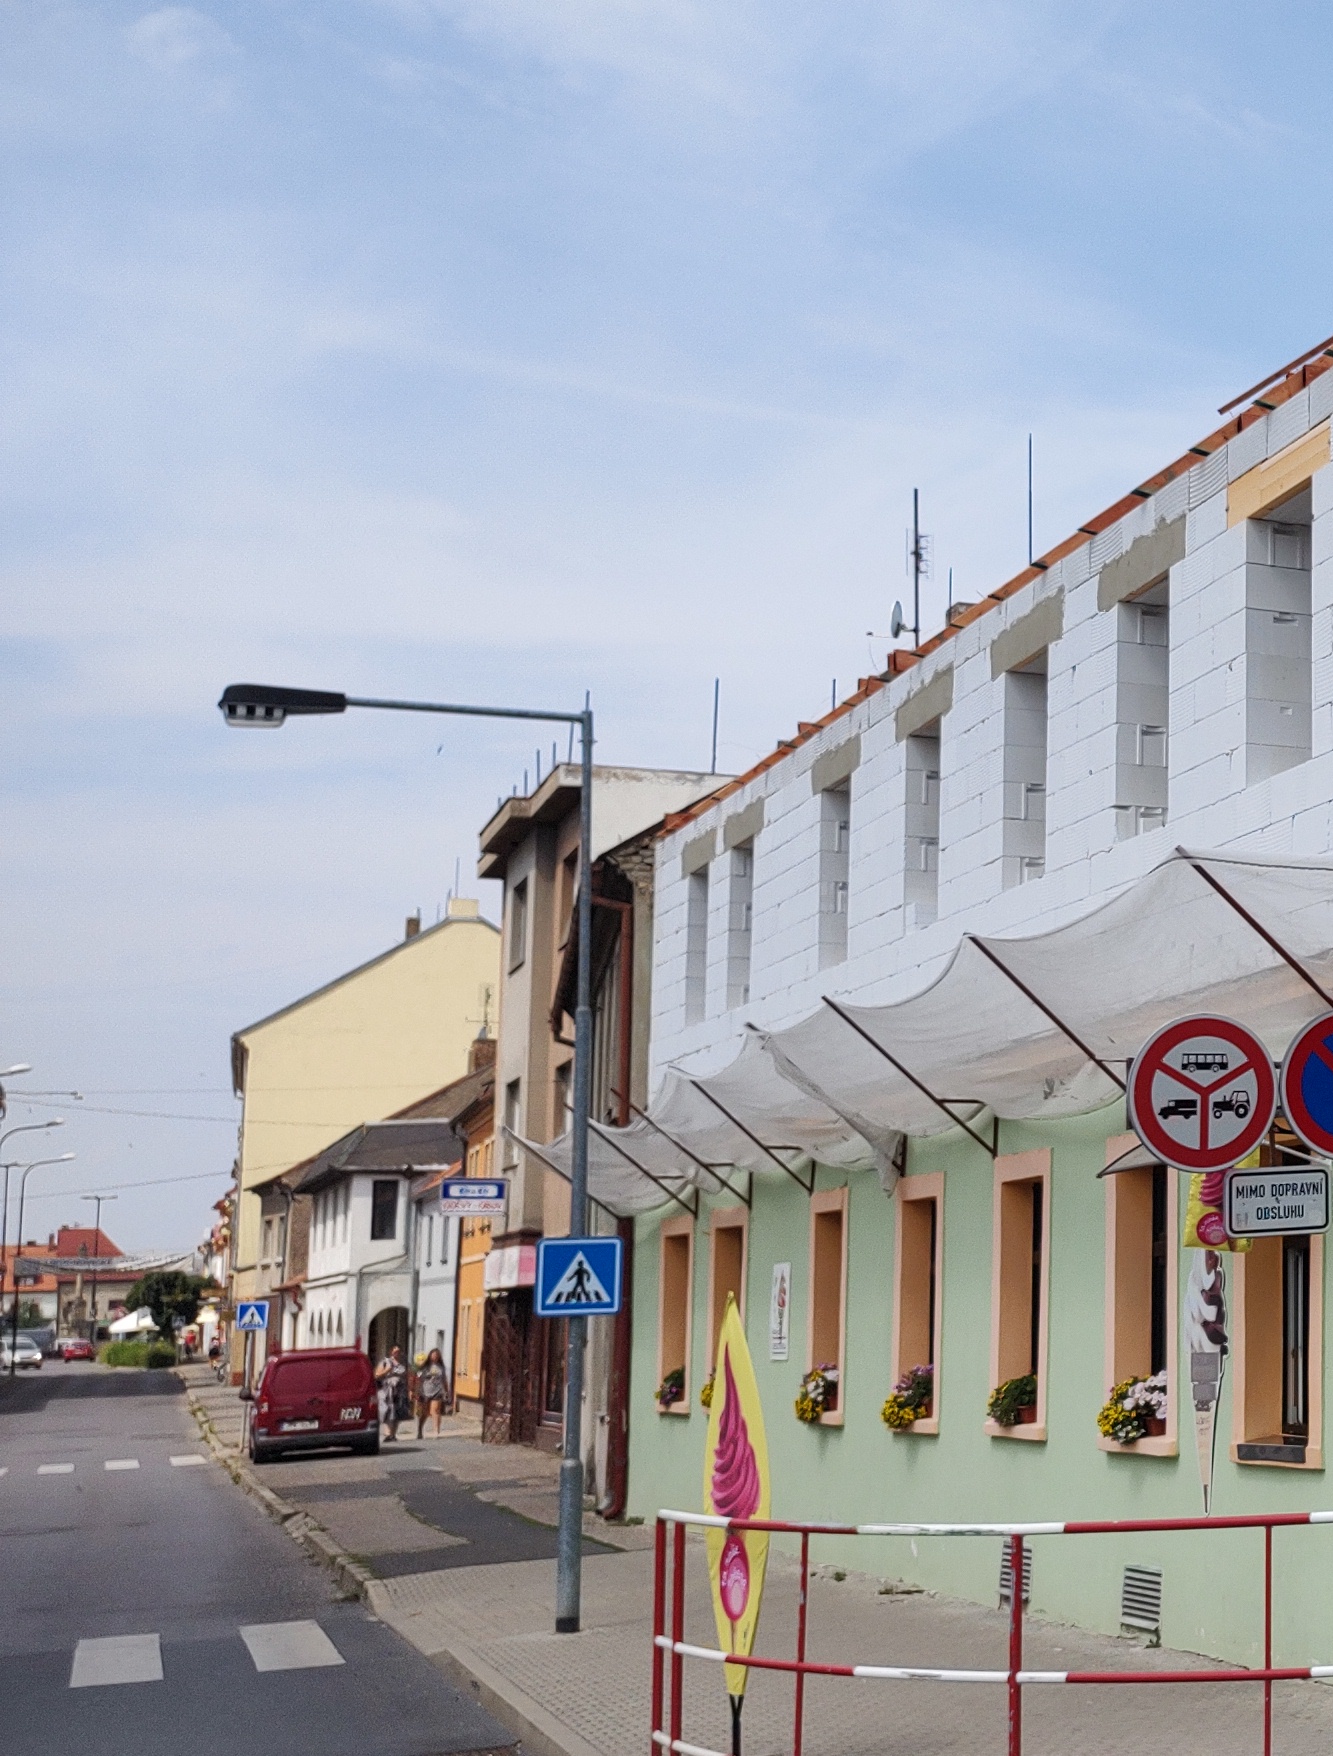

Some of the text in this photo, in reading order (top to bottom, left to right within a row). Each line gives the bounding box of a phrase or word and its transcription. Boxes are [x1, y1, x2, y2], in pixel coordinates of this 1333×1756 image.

[1236, 1177, 1323, 1199] MIMO DOPRAVNÍ
[1256, 1204, 1304, 1221] OBSLUHU
